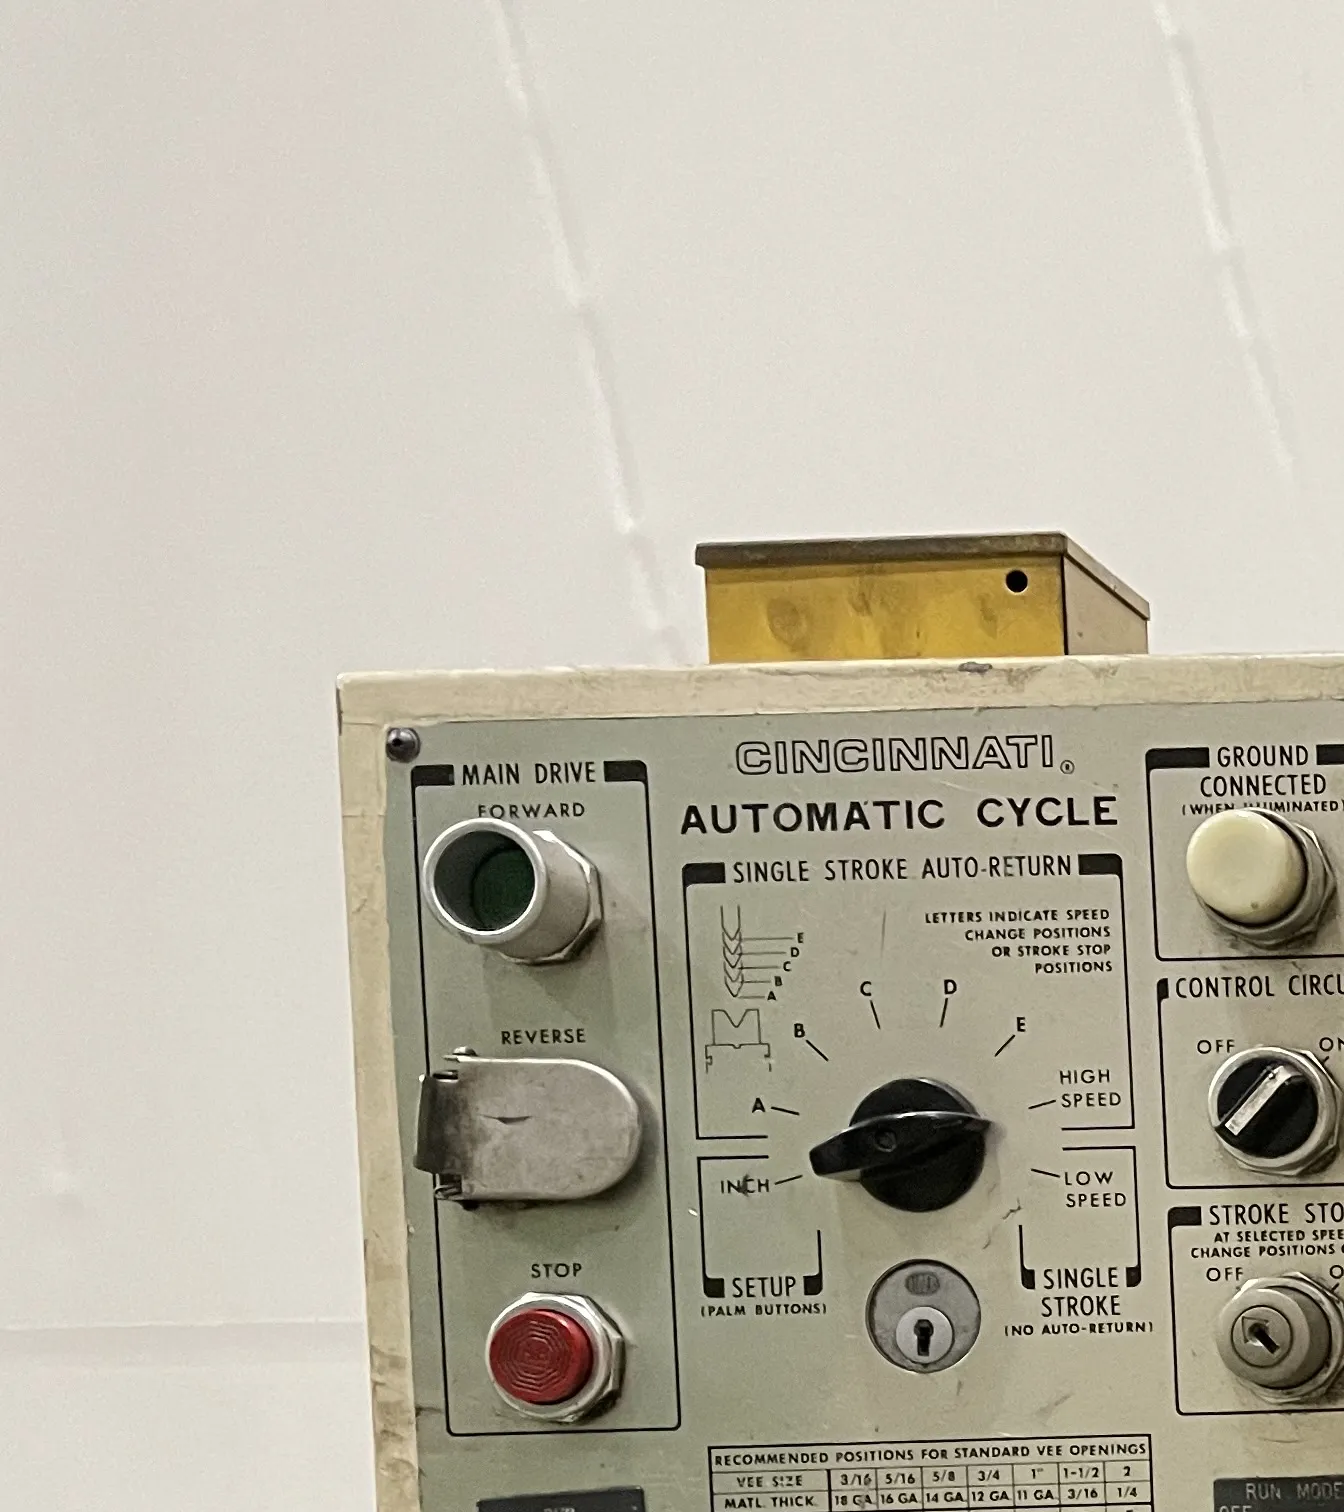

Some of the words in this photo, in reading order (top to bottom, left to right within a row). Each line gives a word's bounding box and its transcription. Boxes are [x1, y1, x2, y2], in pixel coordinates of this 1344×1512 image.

[736, 735, 1054, 775] CINCINNATI
[1217, 745, 1309, 767] GROUND
[462, 764, 521, 785] MAIN
[535, 762, 597, 783] DRIVE
[1200, 774, 1326, 797] CONNECTED
[478, 803, 586, 819] FORWARD
[680, 800, 946, 835] AUTOMATIC
[977, 796, 1119, 827] CYCLE
[733, 861, 810, 883] SINGLE
[824, 858, 908, 881] STROKE
[922, 855, 1073, 879] AUTO-RETURN
[925, 910, 982, 924] LETTERS
[989, 909, 1059, 922] INDICATE
[1066, 908, 1110, 921] SPEED
[965, 928, 1026, 941] CHANGE
[1033, 926, 1111, 939] POSITIONS
[991, 945, 1012, 958] OR
[1018, 944, 1070, 957] STROKE
[1076, 943, 1111, 956] STOP
[1035, 960, 1113, 974] POSITIONS
[1175, 976, 1274, 999] CONTROL
[501, 1028, 587, 1045] REVERSE
[1197, 1039, 1235, 1054] OFF
[1059, 1069, 1111, 1084] HIGH
[1061, 1092, 1122, 1107] SPEED
[720, 1179, 770, 1194] INCH
[1064, 1171, 1114, 1186] LOW
[1066, 1193, 1127, 1208] SPEED
[1209, 1204, 1289, 1226] STROKE
[1213, 1231, 1229, 1243] AT
[1236, 1230, 1306, 1243] SELECTED
[1190, 1246, 1250, 1259] CHANGE
[1258, 1244, 1335, 1257] POSITIONS
[531, 1263, 582, 1278] STOP
[1042, 1267, 1119, 1289] SINGLE
[1206, 1267, 1244, 1282] OFF
[732, 1275, 797, 1298] SETUP
[701, 1305, 745, 1317] (PALM
[755, 1303, 827, 1316] BUTTONS)
[1041, 1295, 1121, 1317] STROKE
[1004, 1324, 1034, 1337] (NO
[1041, 1322, 1154, 1335] AUTO-RETURN)
[714, 1452, 829, 1466] RECOMMENDED
[835, 1449, 914, 1462] POSITIONS
[921, 1449, 948, 1460] FOR
[954, 1446, 1030, 1459] STANDARD
[1036, 1445, 1062, 1456] VEE
[1069, 1443, 1146, 1455] OPENINGS
[1245, 1482, 1282, 1500] RUN
[1296, 1482, 1344, 1499] MODE
